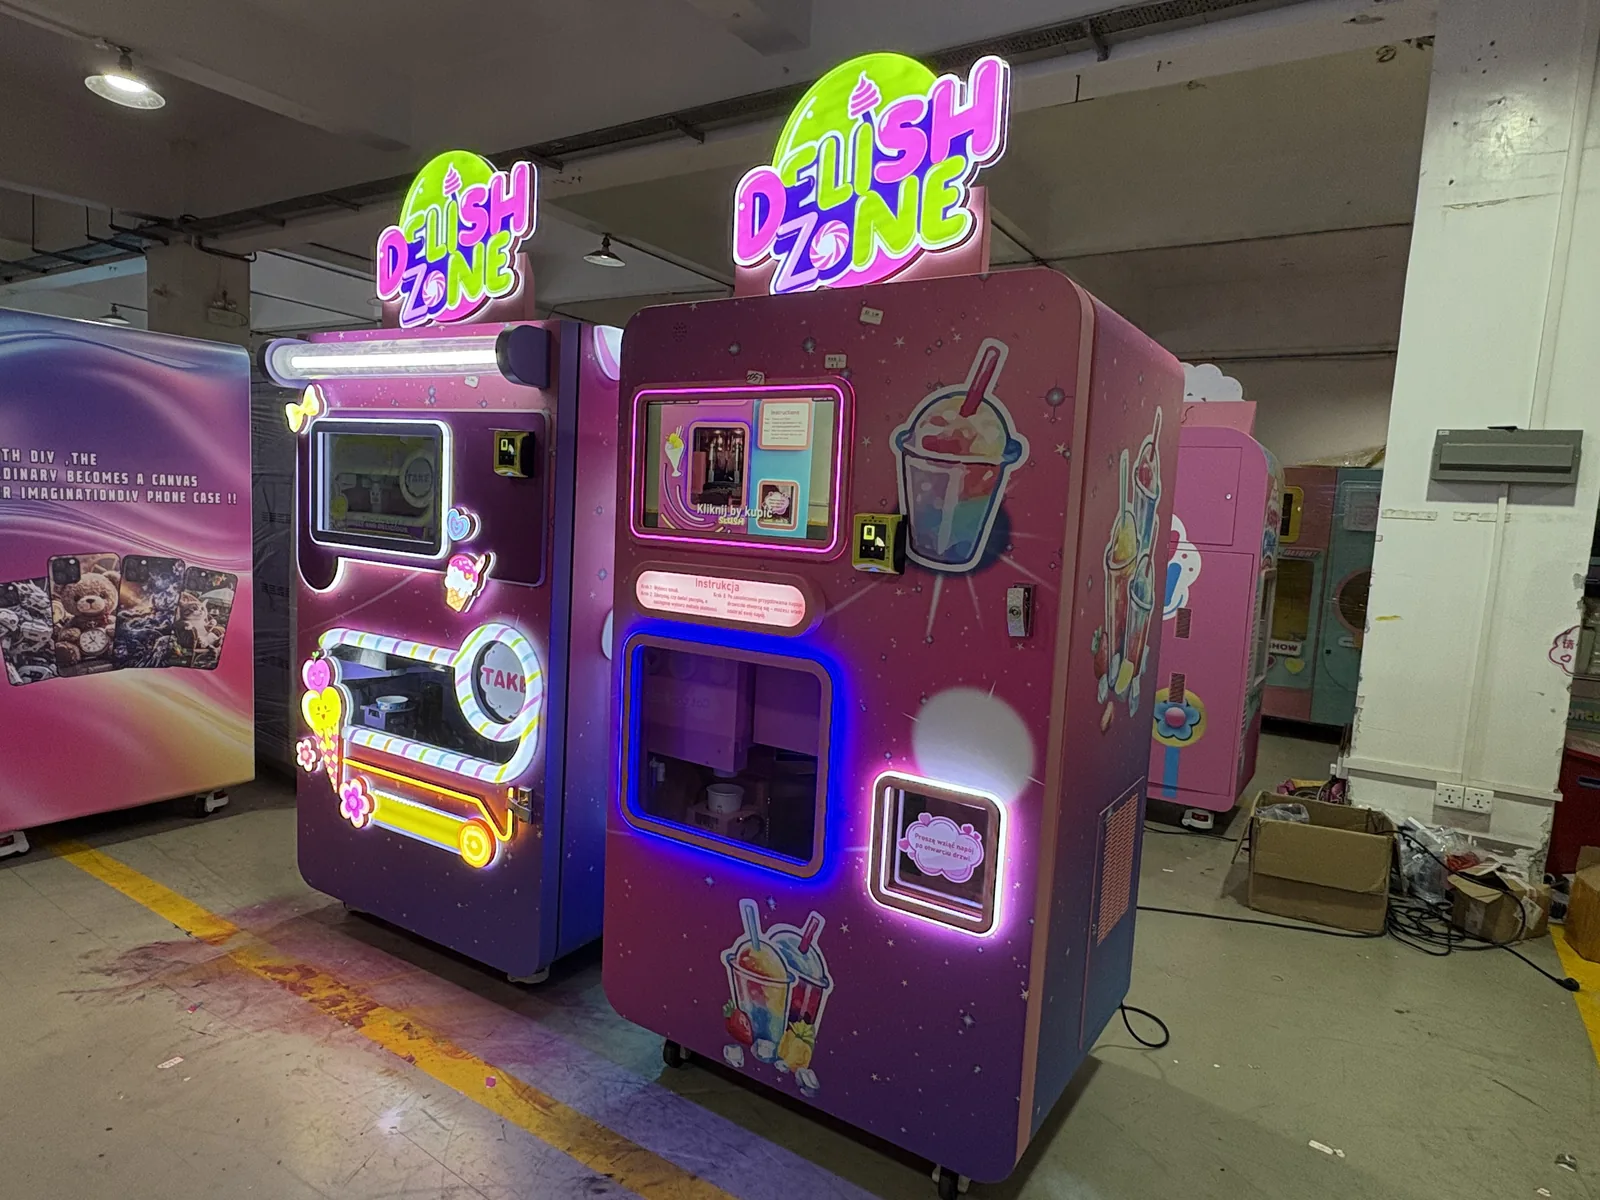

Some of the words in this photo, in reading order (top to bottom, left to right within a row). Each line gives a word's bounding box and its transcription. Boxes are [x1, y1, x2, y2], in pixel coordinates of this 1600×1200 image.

[734, 57, 1003, 266] DELISH
[376, 162, 532, 300] DELISH
[771, 155, 971, 295] ZONE
[400, 229, 514, 328] ZONE
[1, 448, 20, 462] TH
[66, 470, 129, 485] BECOMES
[136, 473, 144, 485] A
[152, 474, 198, 487] CANVAS
[147, 490, 186, 503] PHONE
[193, 491, 221, 504] CASE
[696, 503, 727, 517] Kliknij
[730, 505, 742, 518] by
[695, 578, 740, 594] Instrukcja
